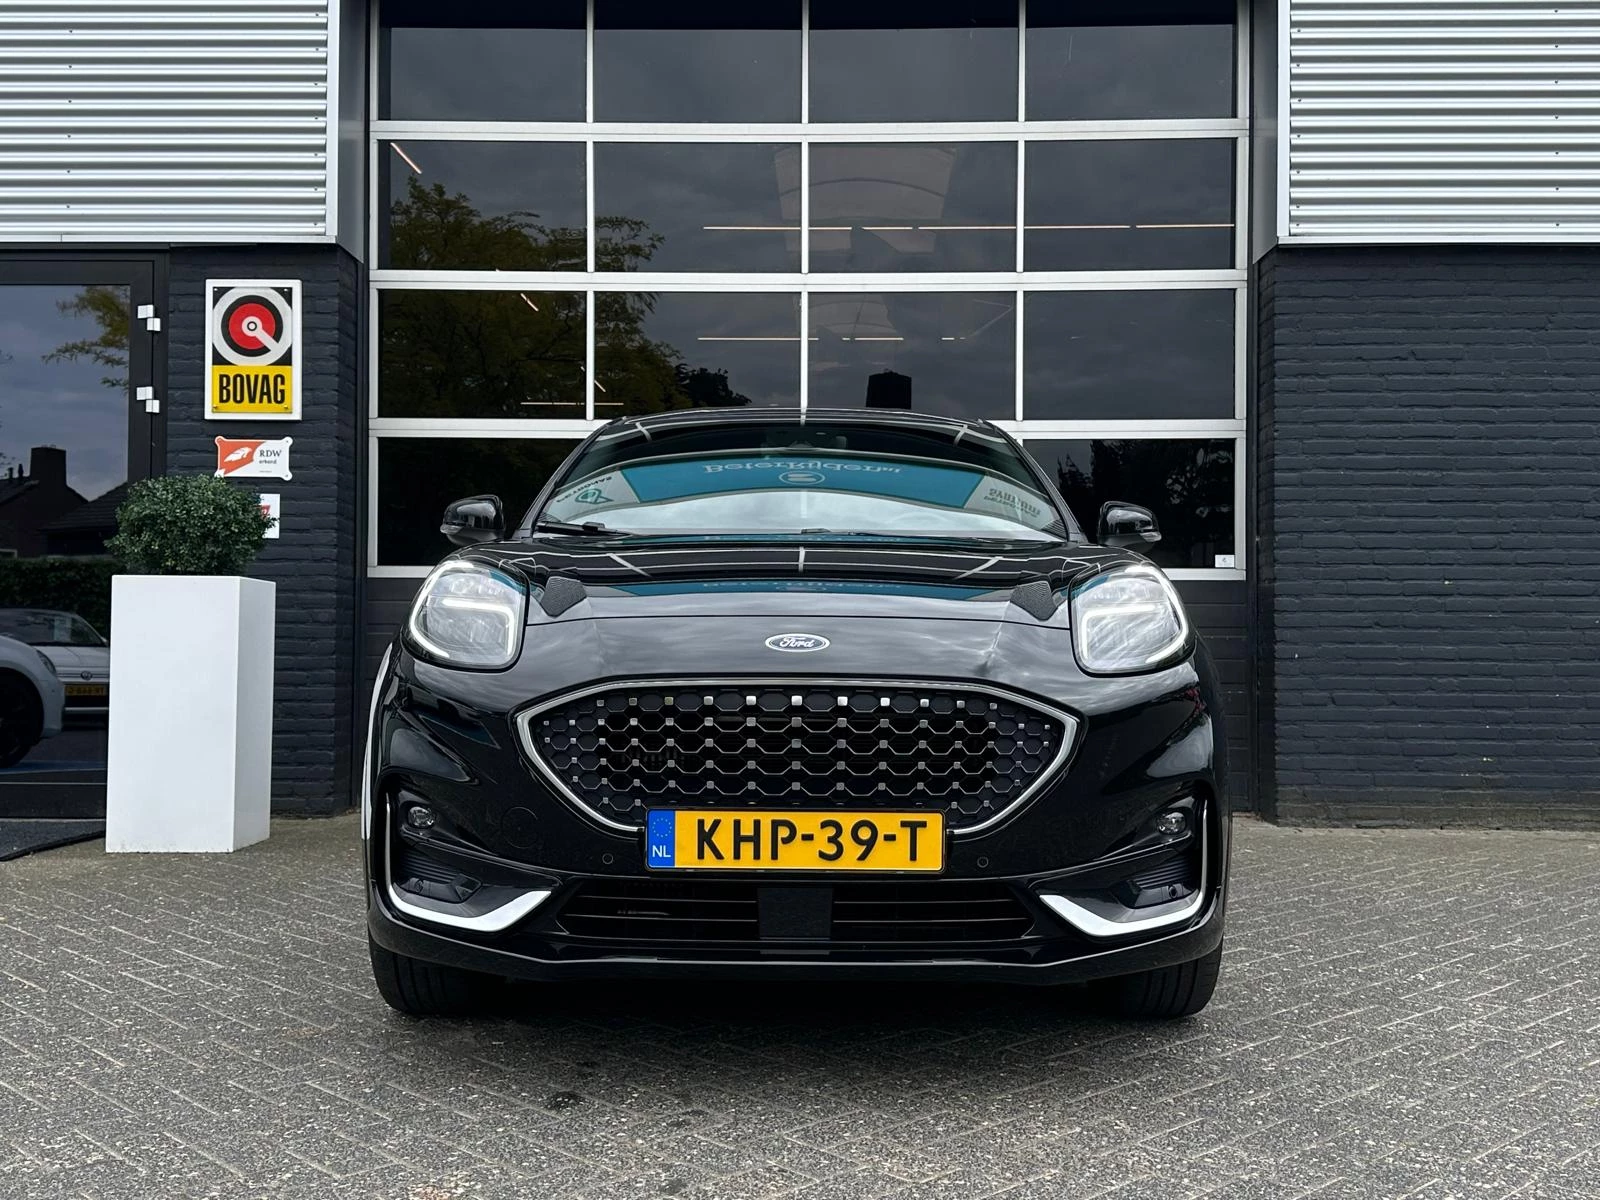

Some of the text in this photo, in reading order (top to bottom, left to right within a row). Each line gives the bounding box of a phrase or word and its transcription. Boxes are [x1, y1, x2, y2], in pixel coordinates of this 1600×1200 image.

[219, 373, 286, 404] BOVAG
[259, 449, 282, 457] RDW
[779, 636, 815, 649] Ford
[696, 818, 928, 862] KHP-39-T
[652, 844, 671, 858] NL
